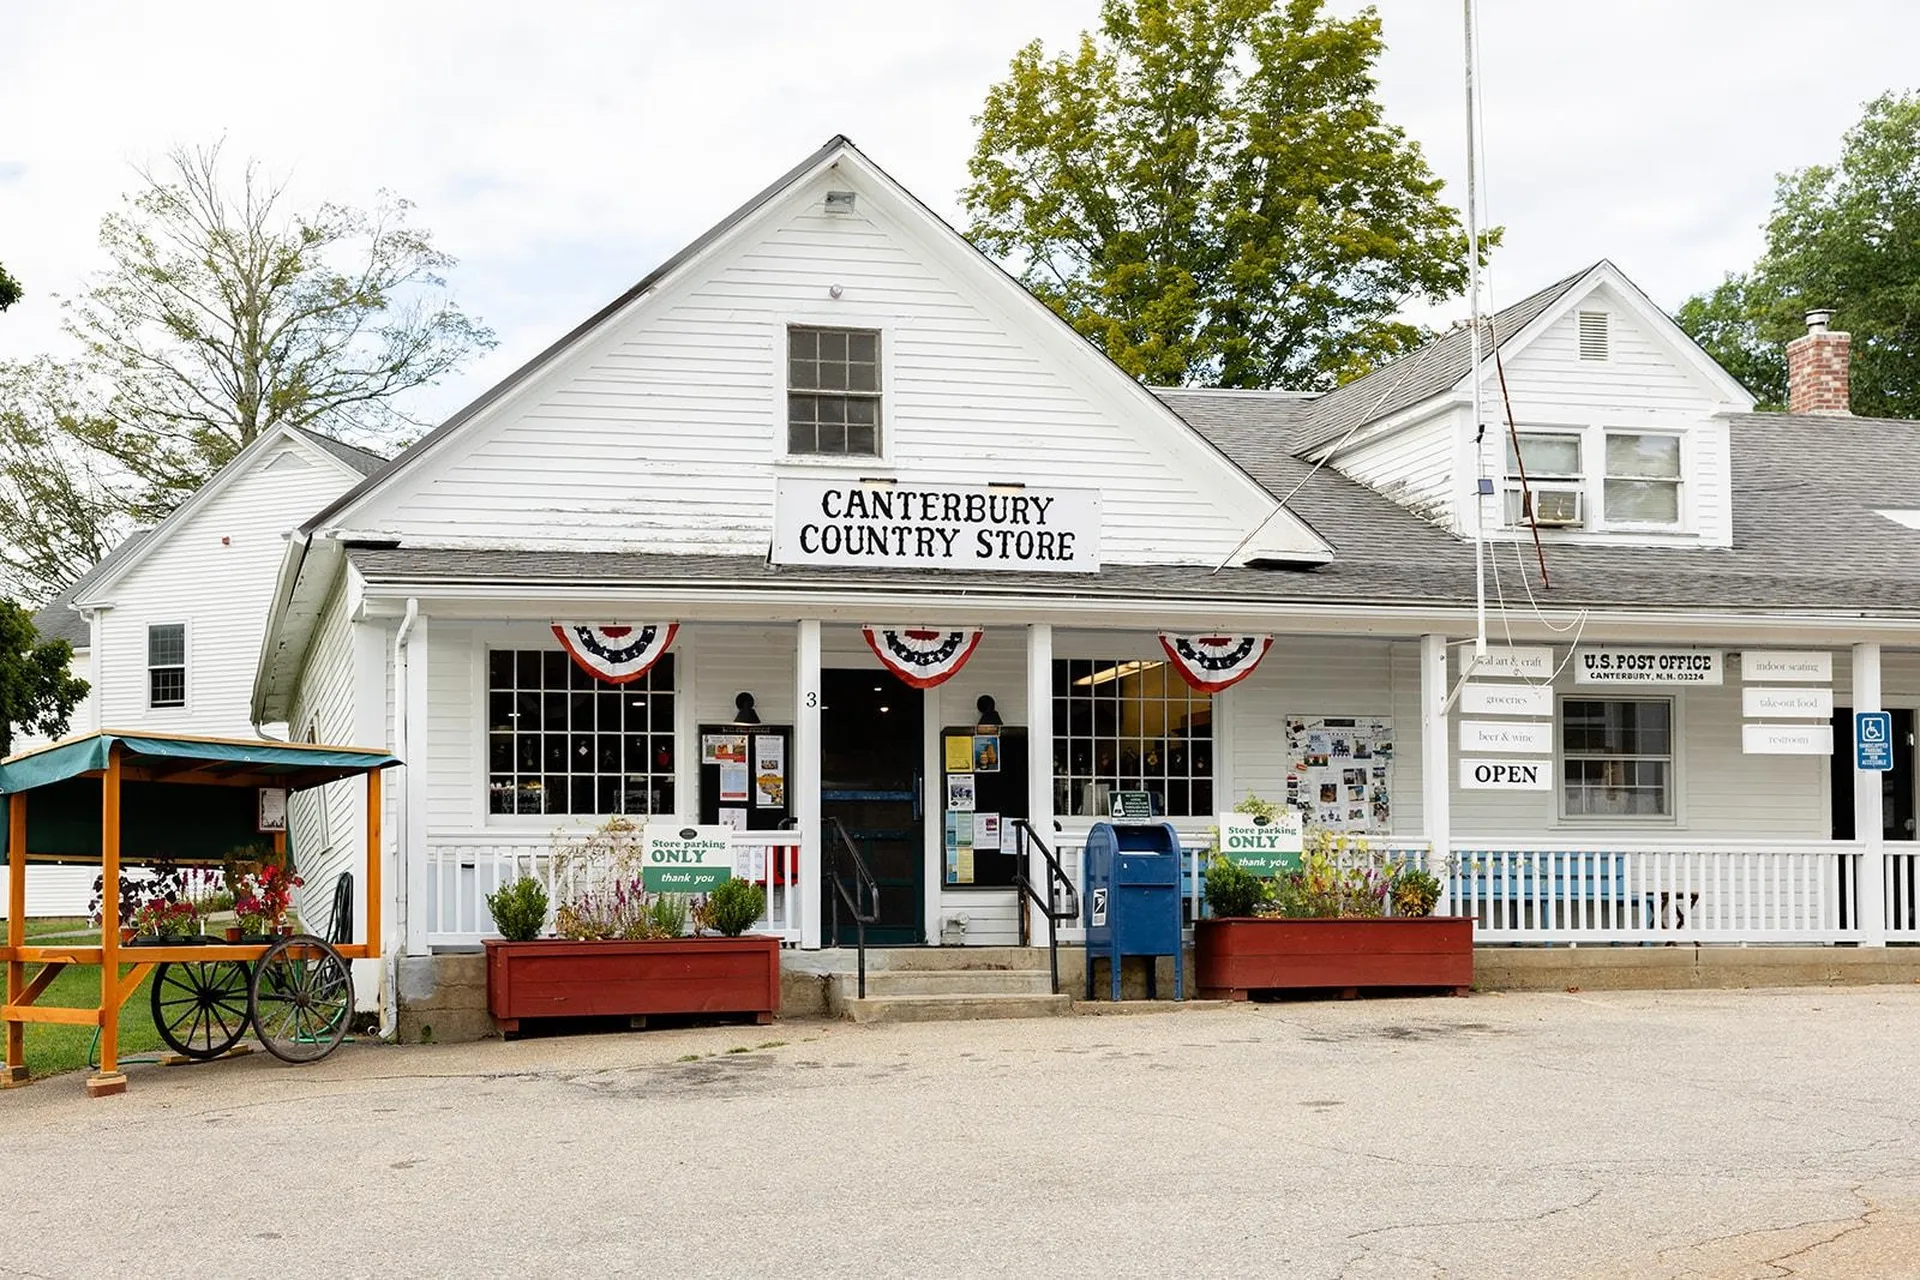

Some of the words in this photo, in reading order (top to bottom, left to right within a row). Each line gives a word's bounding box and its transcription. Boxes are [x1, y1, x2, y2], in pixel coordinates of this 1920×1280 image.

[820, 489, 1054, 526] CANTERBURY
[799, 523, 961, 558] COUNTRY
[976, 528, 1076, 561] STORE
[1496, 657, 1509, 666] art
[1521, 656, 1542, 667] craft
[1584, 654, 1614, 670] U.S.
[1616, 654, 1656, 670] POST
[1659, 655, 1711, 671] OFFICE
[1756, 660, 1786, 671] indoor
[1788, 660, 1819, 673] seating
[1677, 672, 1704, 681] 03224
[806, 691, 817, 708] 3
[1486, 695, 1528, 705] groceries
[1797, 697, 1818, 708] food
[1478, 730, 1499, 741] beer
[1501, 732, 1509, 741] &
[1512, 733, 1533, 743] wine
[1769, 736, 1809, 745] restroom
[1475, 765, 1538, 783] OPEN
[1228, 826, 1255, 834] Store
[1258, 826, 1297, 836] parking
[652, 839, 681, 847] Store
[683, 840, 726, 849] parking
[1228, 835, 1279, 848] ONLY
[651, 849, 707, 863] ONLY
[1239, 856, 1266, 866] thank
[1268, 859, 1289, 868] you
[661, 872, 691, 882] thank
[693, 874, 715, 885] you
